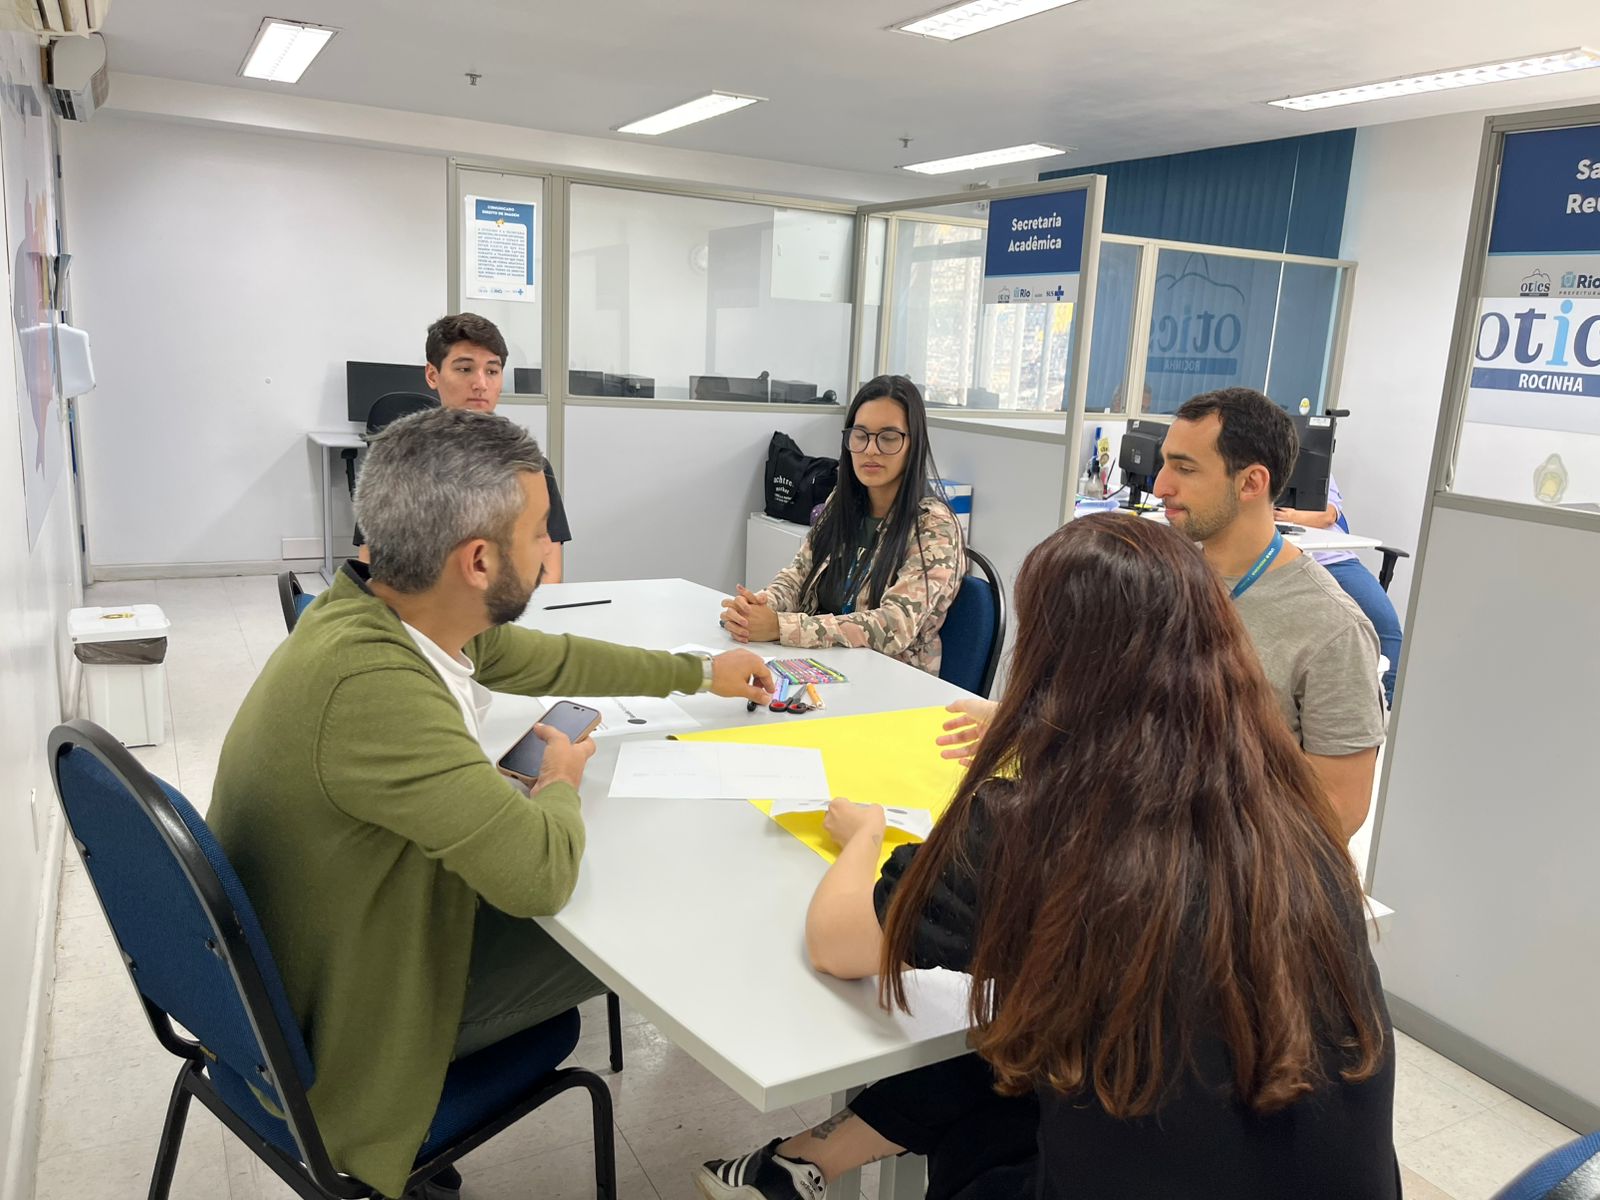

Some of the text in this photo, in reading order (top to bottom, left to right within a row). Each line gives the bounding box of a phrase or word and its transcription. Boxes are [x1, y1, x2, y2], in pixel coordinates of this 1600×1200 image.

[1011, 212, 1062, 231] Secretaria
[1008, 234, 1062, 252] Acadêmica
[1020, 288, 1031, 298] Rio
[1518, 373, 1583, 392] ROCINHA
